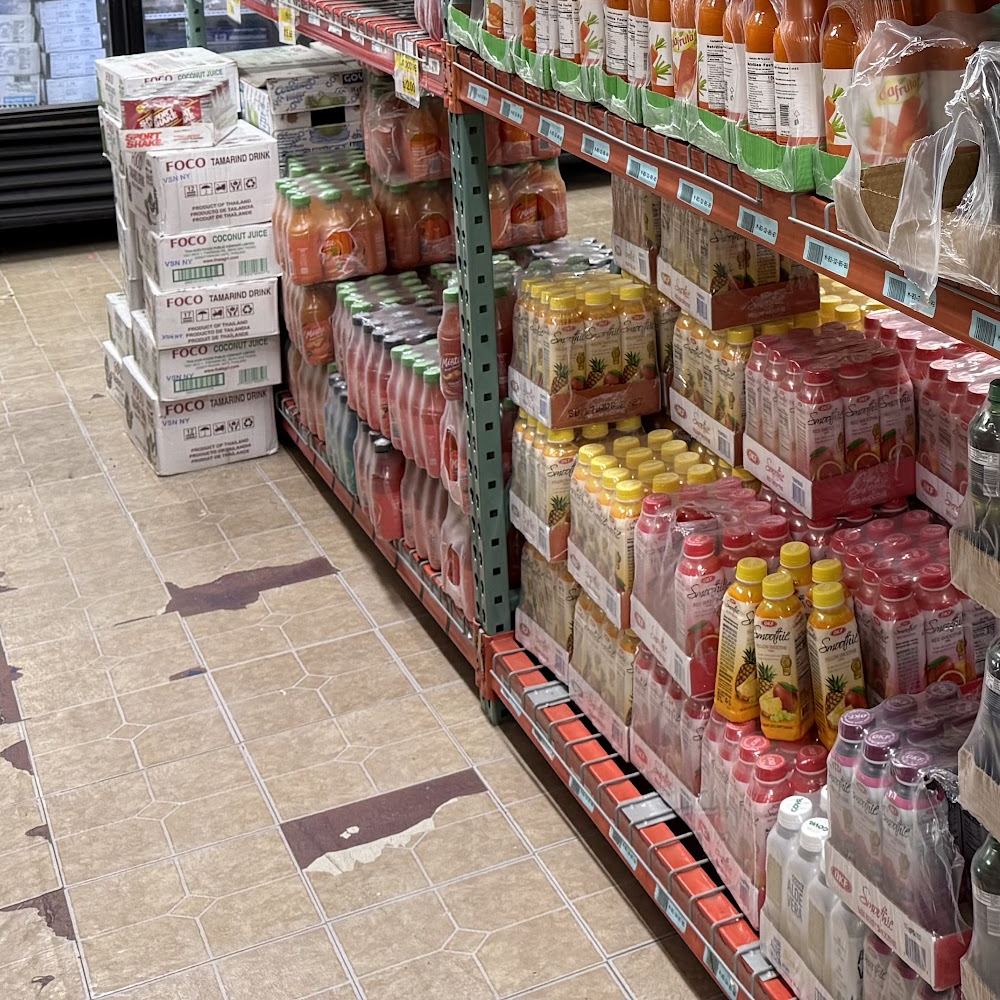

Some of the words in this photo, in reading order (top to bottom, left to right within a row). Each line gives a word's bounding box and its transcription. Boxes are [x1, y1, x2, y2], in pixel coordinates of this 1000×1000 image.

[177, 71, 204, 81] COCONUT
[206, 68, 223, 78] JUICE
[125, 131, 162, 141] SPORT
[125, 138, 162, 149] SHAKE
[165, 157, 206, 172] FOCO
[211, 153, 247, 167] TAMARIND
[249, 150, 271, 161] DRINK
[162, 175, 178, 184] VSN
[192, 202, 217, 211] PRODUCT
[170, 235, 207, 249] FOCO
[212, 231, 246, 243] COCONUT
[248, 229, 268, 238] JUICE
[165, 259, 181, 267] VSN
[181, 258, 193, 266] NY
[166, 294, 203, 308] FOCO
[209, 290, 247, 303] TAMARIND
[249, 286, 272, 297] DRINK
[187, 323, 213, 332] PRODUCT
[172, 345, 208, 360] FOCO
[213, 341, 247, 354] COCONUT
[249, 338, 269, 347] JUICE
[164, 400, 205, 417] FOCO
[210, 393, 246, 408] TAMARIND
[248, 389, 267, 402] DRINK
[162, 418, 178, 427] VSN
[753, 624, 791, 645] Smoothie
[818, 631, 859, 654] Smoothie
[859, 885, 895, 931] Smoothie
